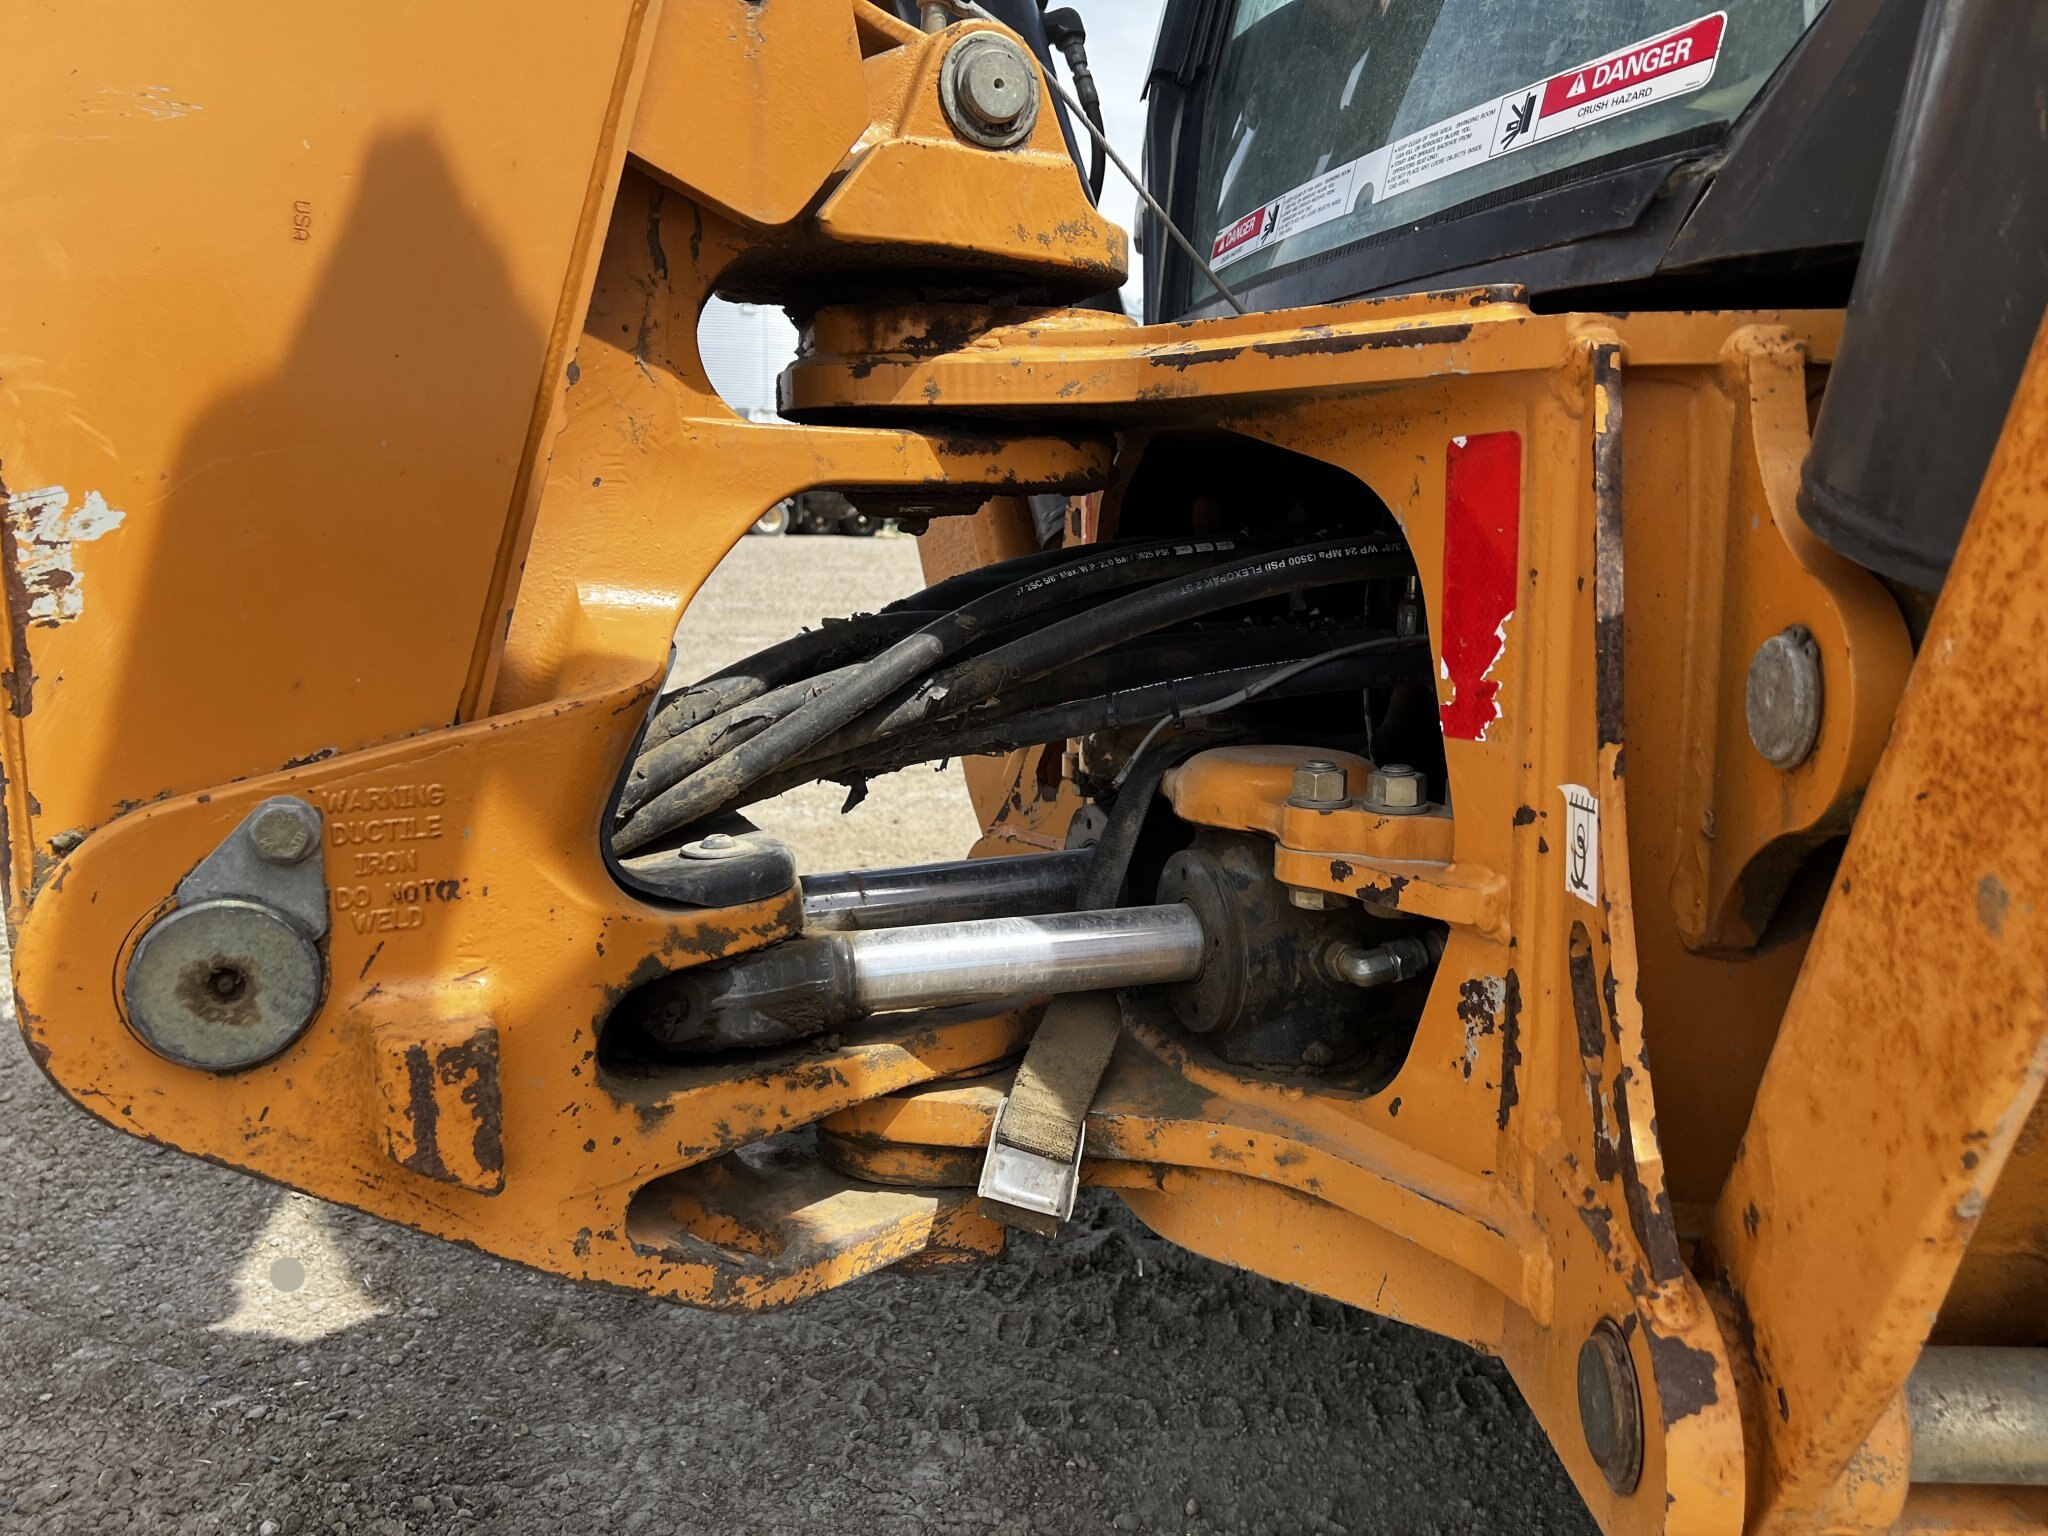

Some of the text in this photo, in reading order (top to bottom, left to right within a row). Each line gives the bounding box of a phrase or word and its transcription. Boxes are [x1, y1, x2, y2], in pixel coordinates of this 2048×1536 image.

[1592, 37, 1693, 90] DANGER
[1577, 87, 1653, 118] CRUSH HAZARD
[293, 200, 312, 241] USA
[1225, 216, 1256, 248] DANGER
[1288, 553, 1317, 567] (3500
[1319, 549, 1342, 559] MPa
[1344, 547, 1358, 556] 24
[1360, 544, 1379, 554] WP
[1024, 579, 1043, 591] 2SC
[1154, 548, 1170, 557] PSI
[1204, 564, 1263, 589] FLEXOPAK
[321, 783, 446, 814] WARNING
[330, 814, 443, 847] DUCTILE
[353, 848, 418, 877] IRON
[334, 878, 436, 911] DO NOT
[351, 905, 425, 935] WELD
